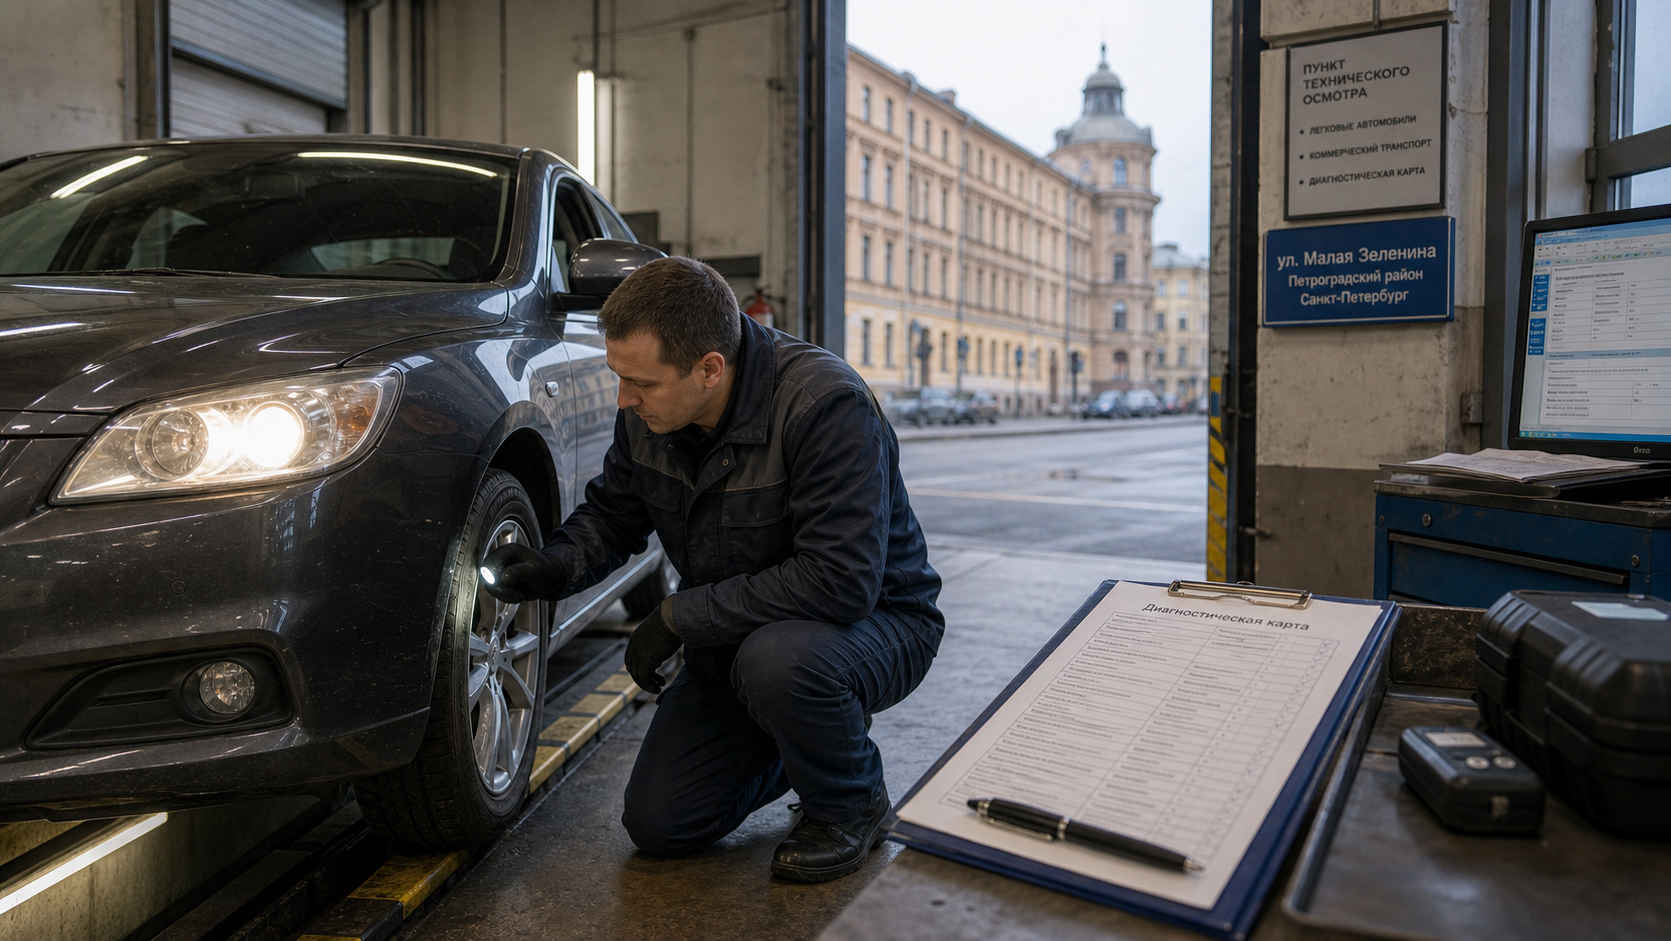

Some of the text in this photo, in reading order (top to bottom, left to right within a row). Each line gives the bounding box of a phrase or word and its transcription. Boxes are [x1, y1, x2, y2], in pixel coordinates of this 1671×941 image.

[1303, 59, 1346, 75] ПУНКТ
[1303, 66, 1410, 90] ТЕХНИЧЕСКОГО
[1303, 87, 1368, 105] ОСМОТРА
[1309, 115, 1417, 135] ЛЕГКОВЫЕ АВТОМОБИЛИ
[1309, 138, 1432, 160] КОММЕРЧЕСКИЙ ТРАНСПОРТ
[1308, 166, 1426, 187] ДИАГНОСТИЧЕСКАЯ КАРТА
[1277, 245, 1437, 271] ул. Малая Зеленина
[1288, 269, 1424, 289] Петроградский район
[1300, 288, 1409, 306] Санкт-Петербург
[1142, 603, 1310, 631] Диагностическая карта
